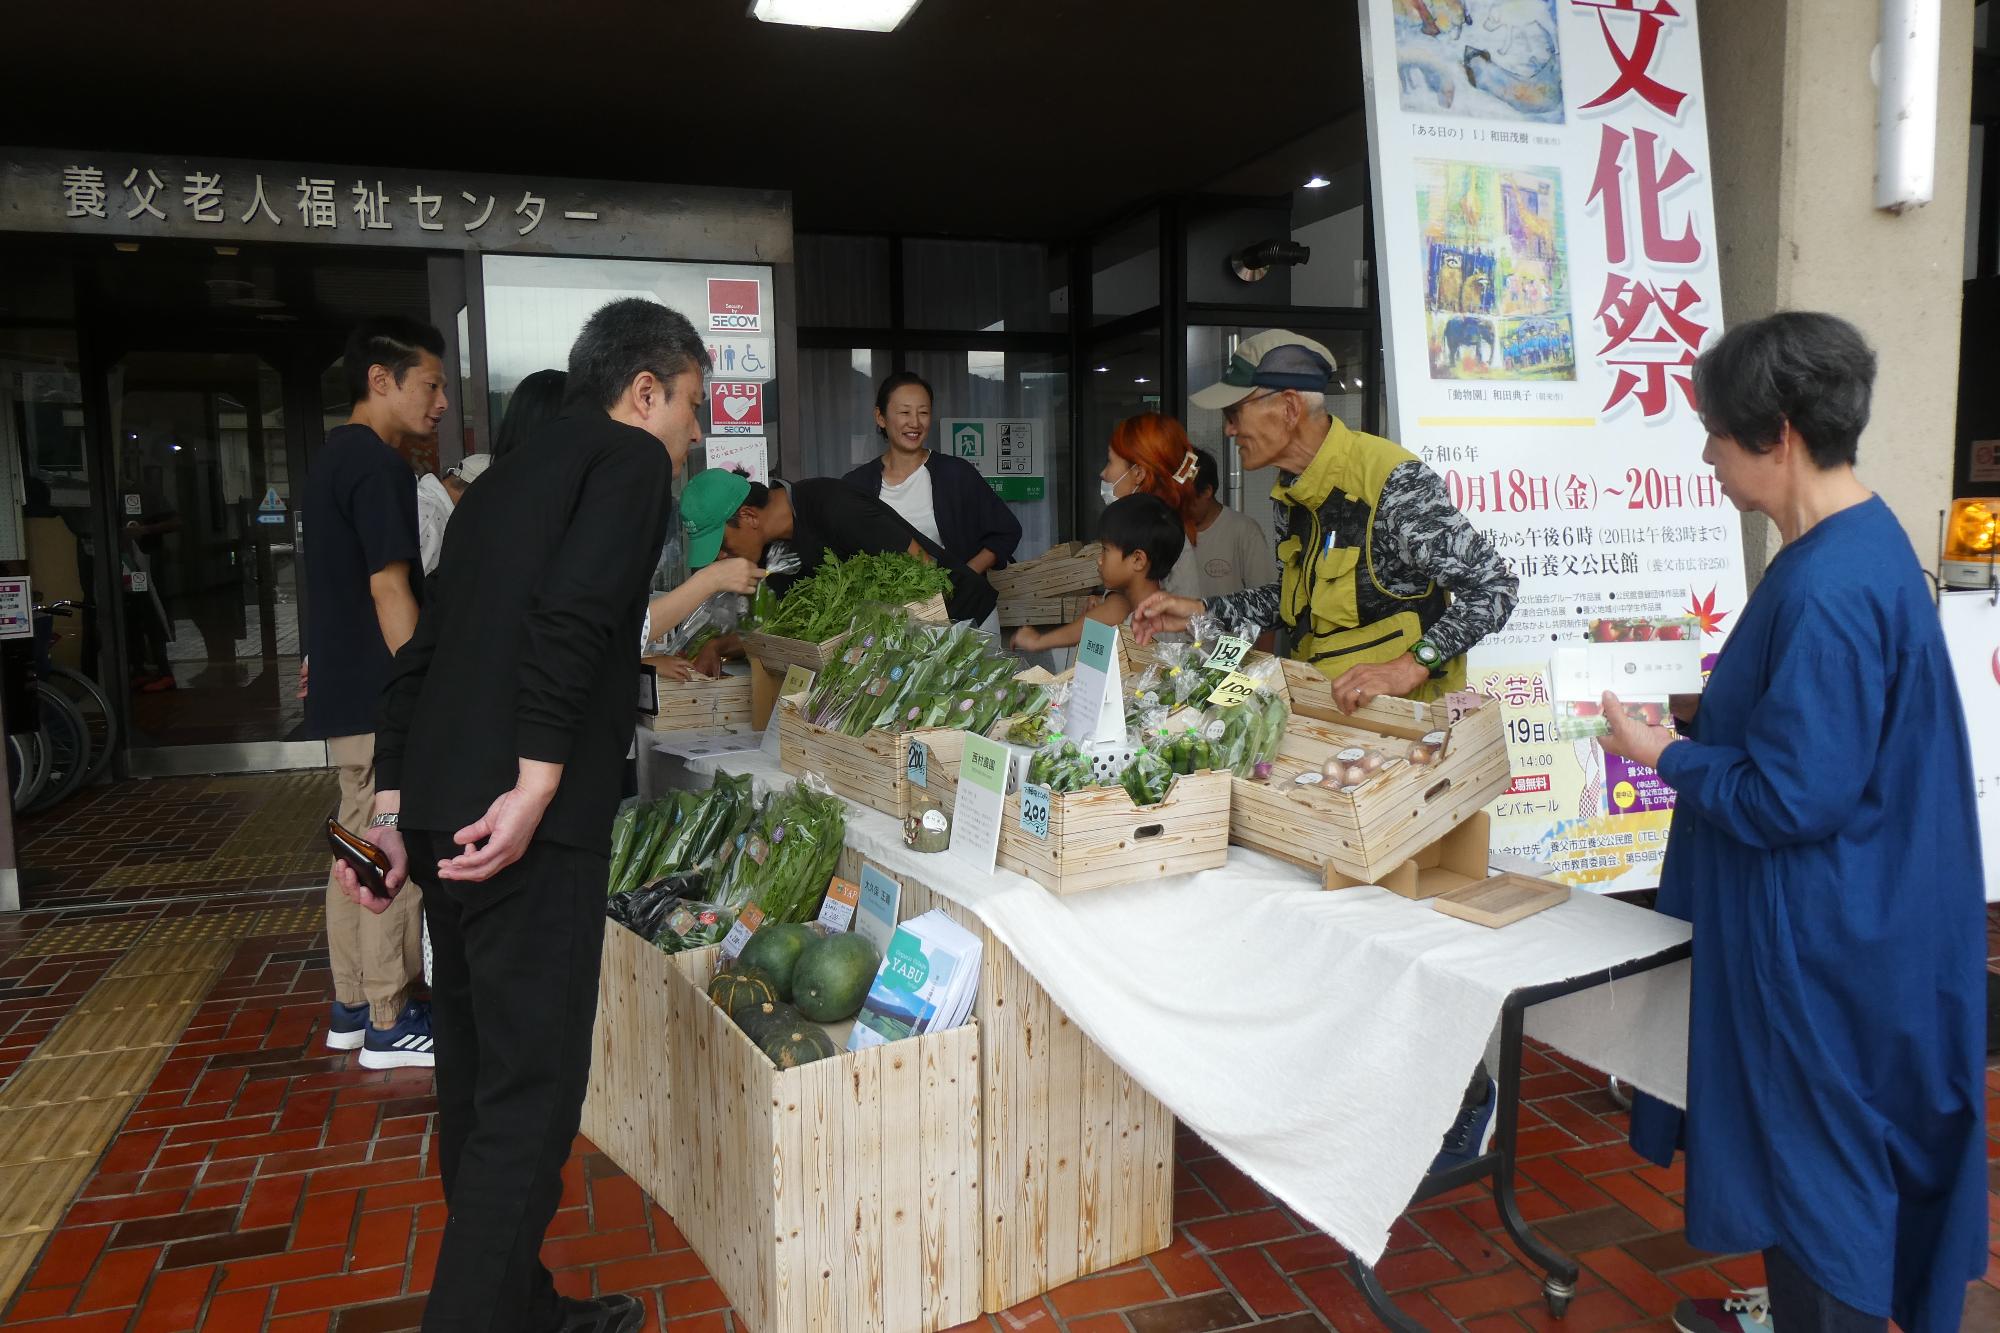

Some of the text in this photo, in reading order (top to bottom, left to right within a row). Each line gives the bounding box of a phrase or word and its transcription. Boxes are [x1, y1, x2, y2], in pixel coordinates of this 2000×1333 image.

[62, 164, 600, 236] 養父老人福祉センター
[1571, 0, 1709, 417] 文化祭
[712, 315, 758, 328] SECOM
[715, 384, 758, 396] AED
[724, 426, 751, 434] SECOM
[1420, 444, 1479, 463] 令和6年
[1211, 643, 1241, 660] 150
[1220, 682, 1253, 695] 100
[1520, 754, 1553, 767] 14:00
[1496, 799, 1559, 817] ビバホール
[1640, 797, 1653, 805] TEL
[1024, 799, 1046, 821] 200
[1551, 833, 1633, 853] 養父市立養父公民館
[892, 957, 924, 984] YABU
